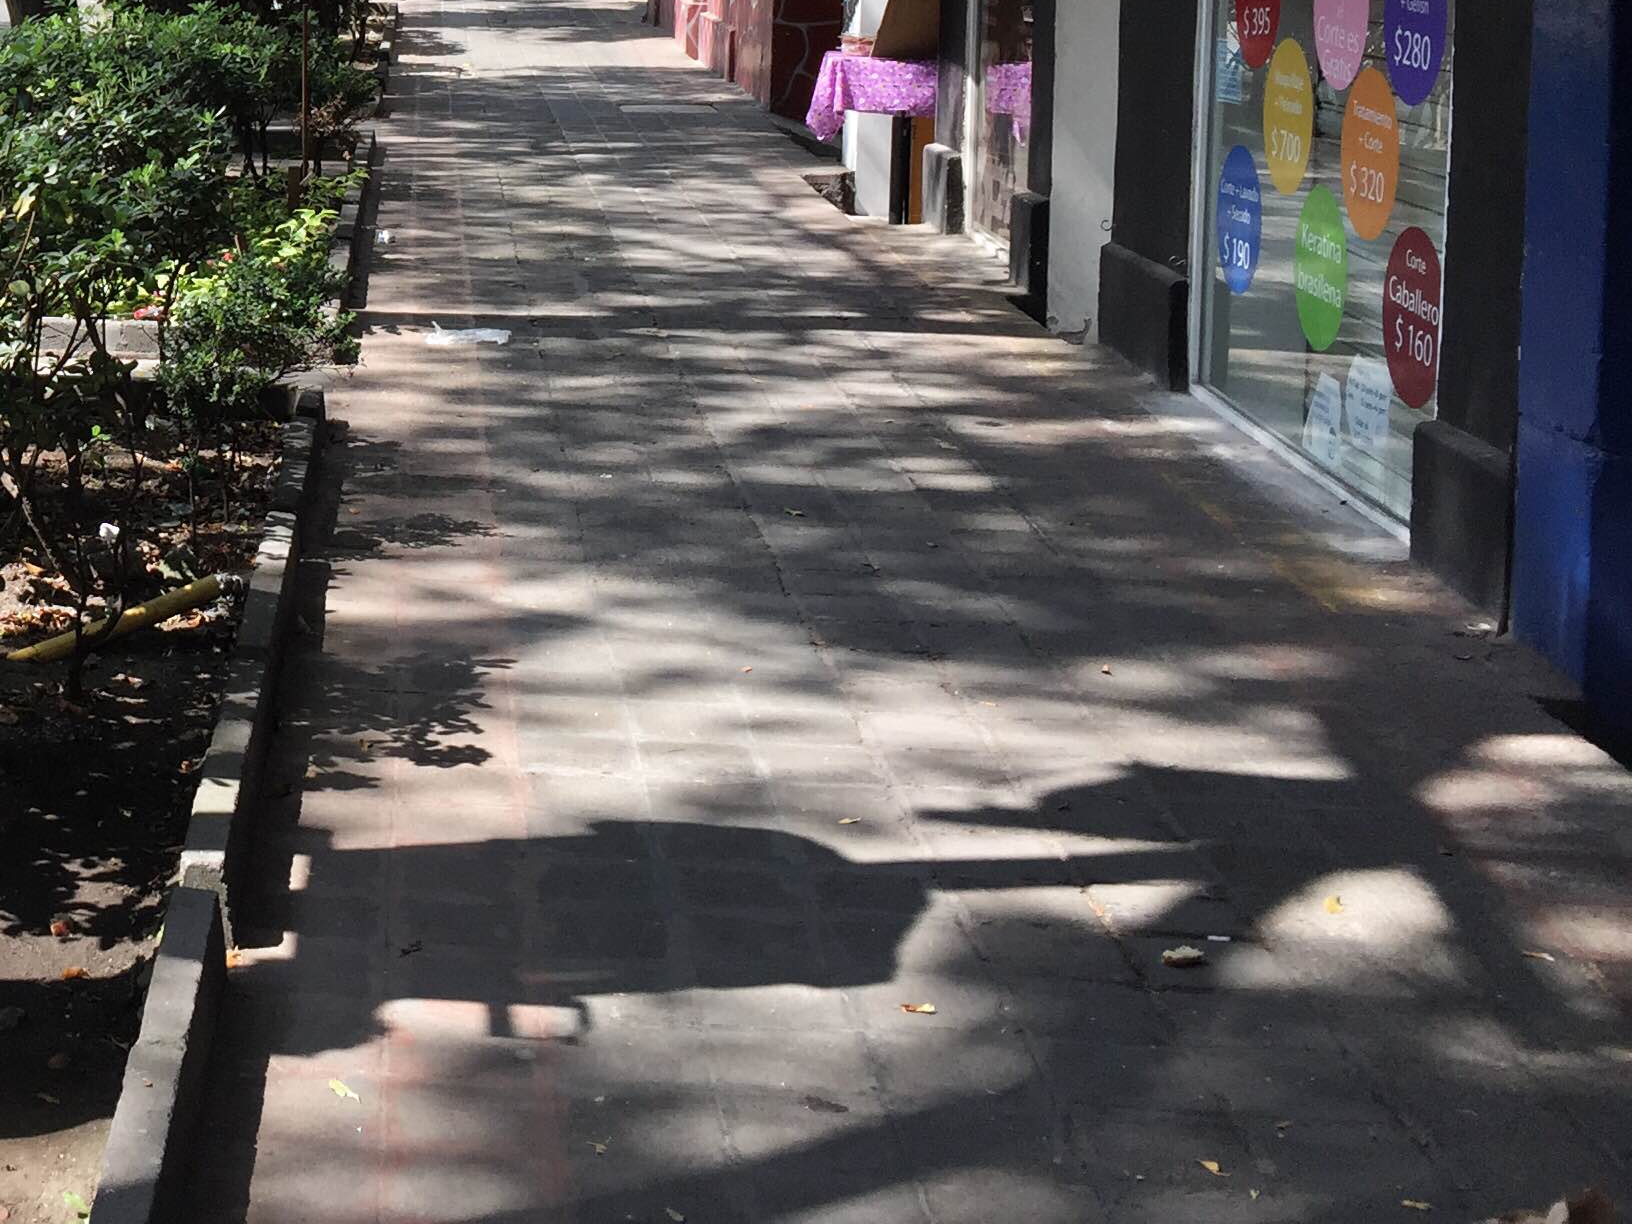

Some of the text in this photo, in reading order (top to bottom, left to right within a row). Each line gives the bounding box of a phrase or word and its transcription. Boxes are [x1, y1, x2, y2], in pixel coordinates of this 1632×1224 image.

[1301, 223, 1342, 264] Keratina
[1406, 248, 1427, 276] Corte
[1388, 274, 1440, 327] Caballero
